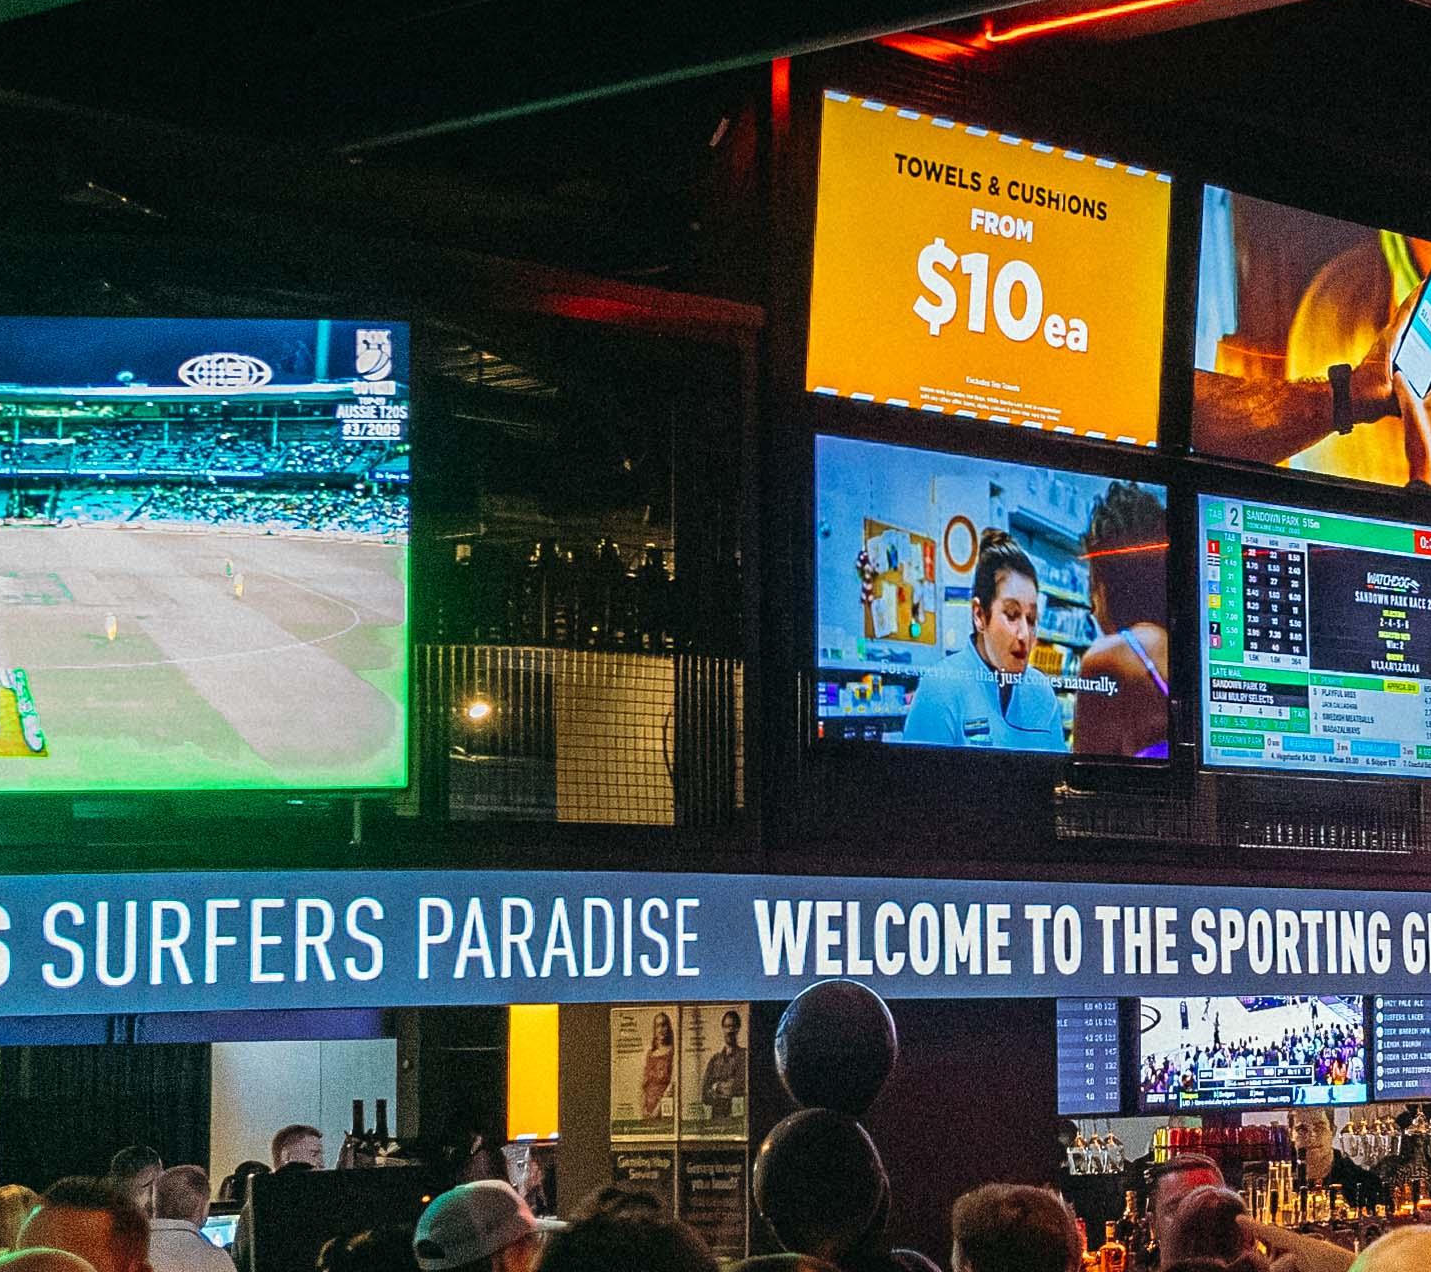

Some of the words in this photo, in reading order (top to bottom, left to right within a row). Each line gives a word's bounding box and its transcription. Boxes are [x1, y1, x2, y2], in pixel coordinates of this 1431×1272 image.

[894, 153, 982, 192] TOWELS
[988, 176, 1000, 196] &
[1007, 180, 1108, 221] CUSHIONS
[971, 207, 1033, 243] FROM
[336, 404, 378, 419] AUSSIE
[379, 406, 409, 419] T20S
[1230, 508, 1239, 526] 2
[1246, 510, 1280, 524] SANDOWN
[1282, 515, 1299, 526] PARK
[1211, 543, 1216, 551] 1
[1367, 572, 1410, 589] WATCHDOG
[1355, 591, 1388, 605] SANDOWN
[1212, 624, 1218, 633] 7
[1000, 669, 1022, 688] just
[1064, 676, 1118, 697] naturally.
[42, 898, 384, 987] SURFERS
[418, 897, 700, 979] PARADISE
[753, 899, 1012, 976] WELCOME
[1024, 904, 1082, 975] TO
[1095, 905, 1179, 974] THE
[1191, 907, 1392, 975] SPORTING
